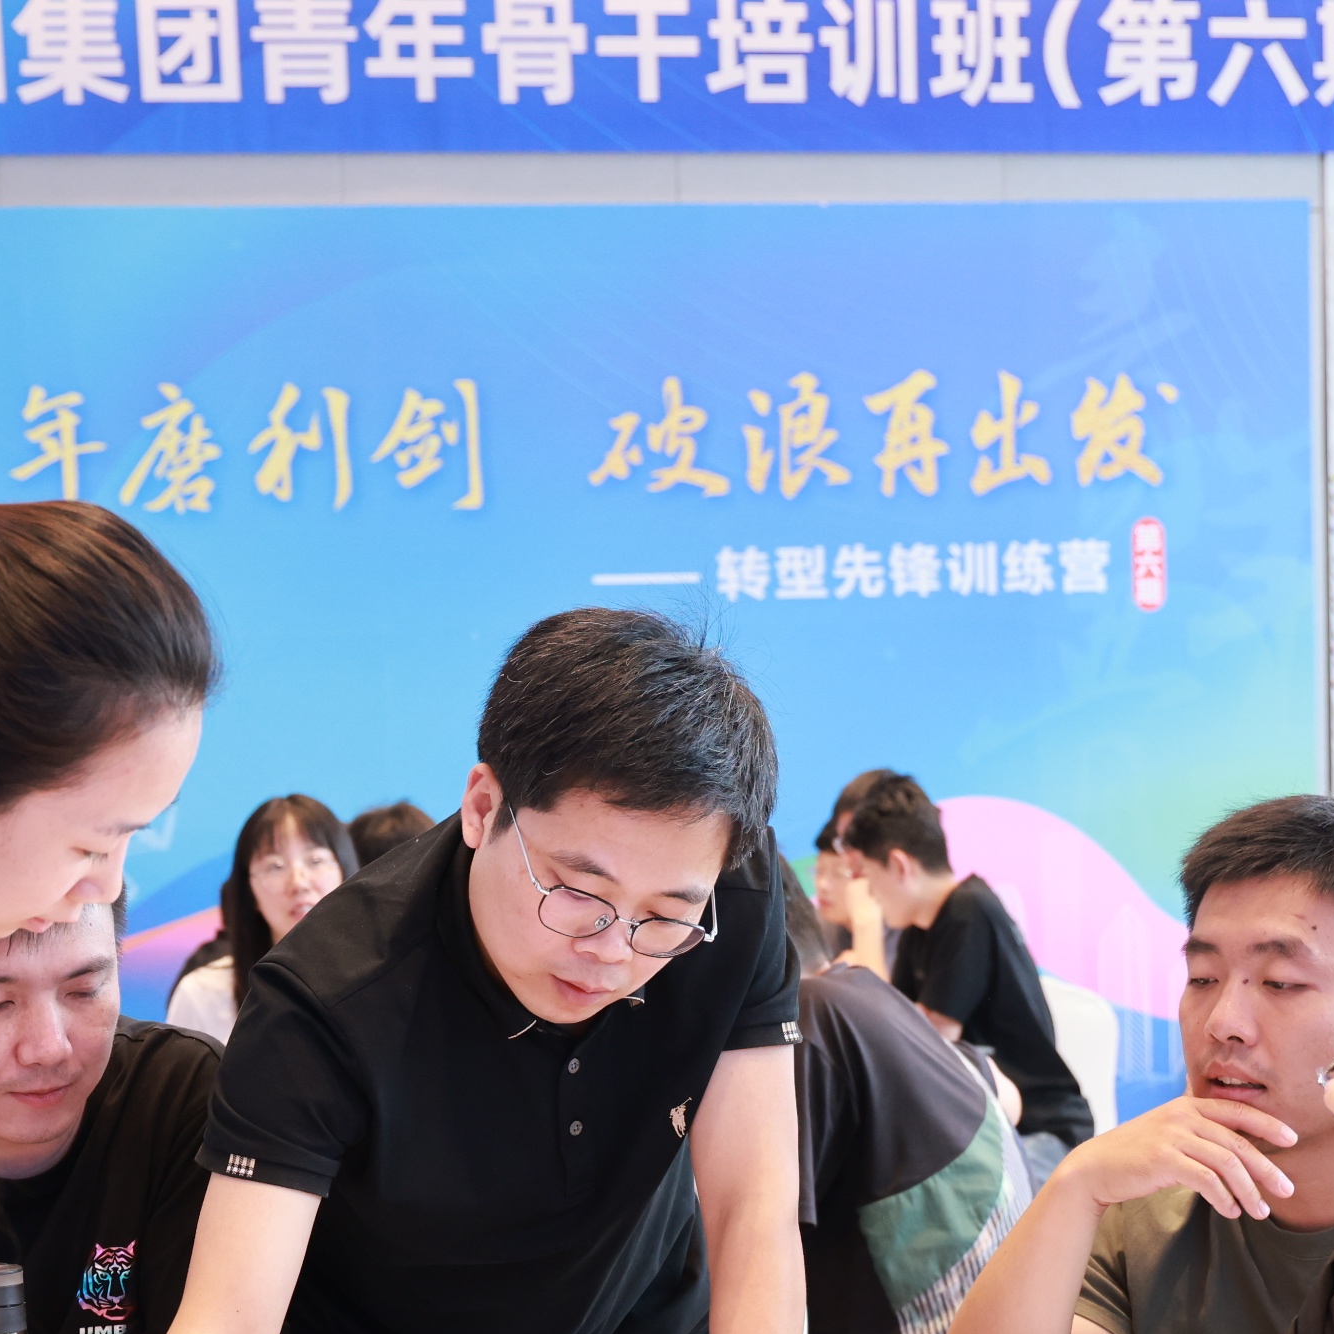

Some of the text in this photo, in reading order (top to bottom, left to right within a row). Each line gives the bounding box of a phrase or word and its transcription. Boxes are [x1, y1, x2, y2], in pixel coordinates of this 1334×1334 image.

[588, 369, 1179, 500] 破浪再出发
